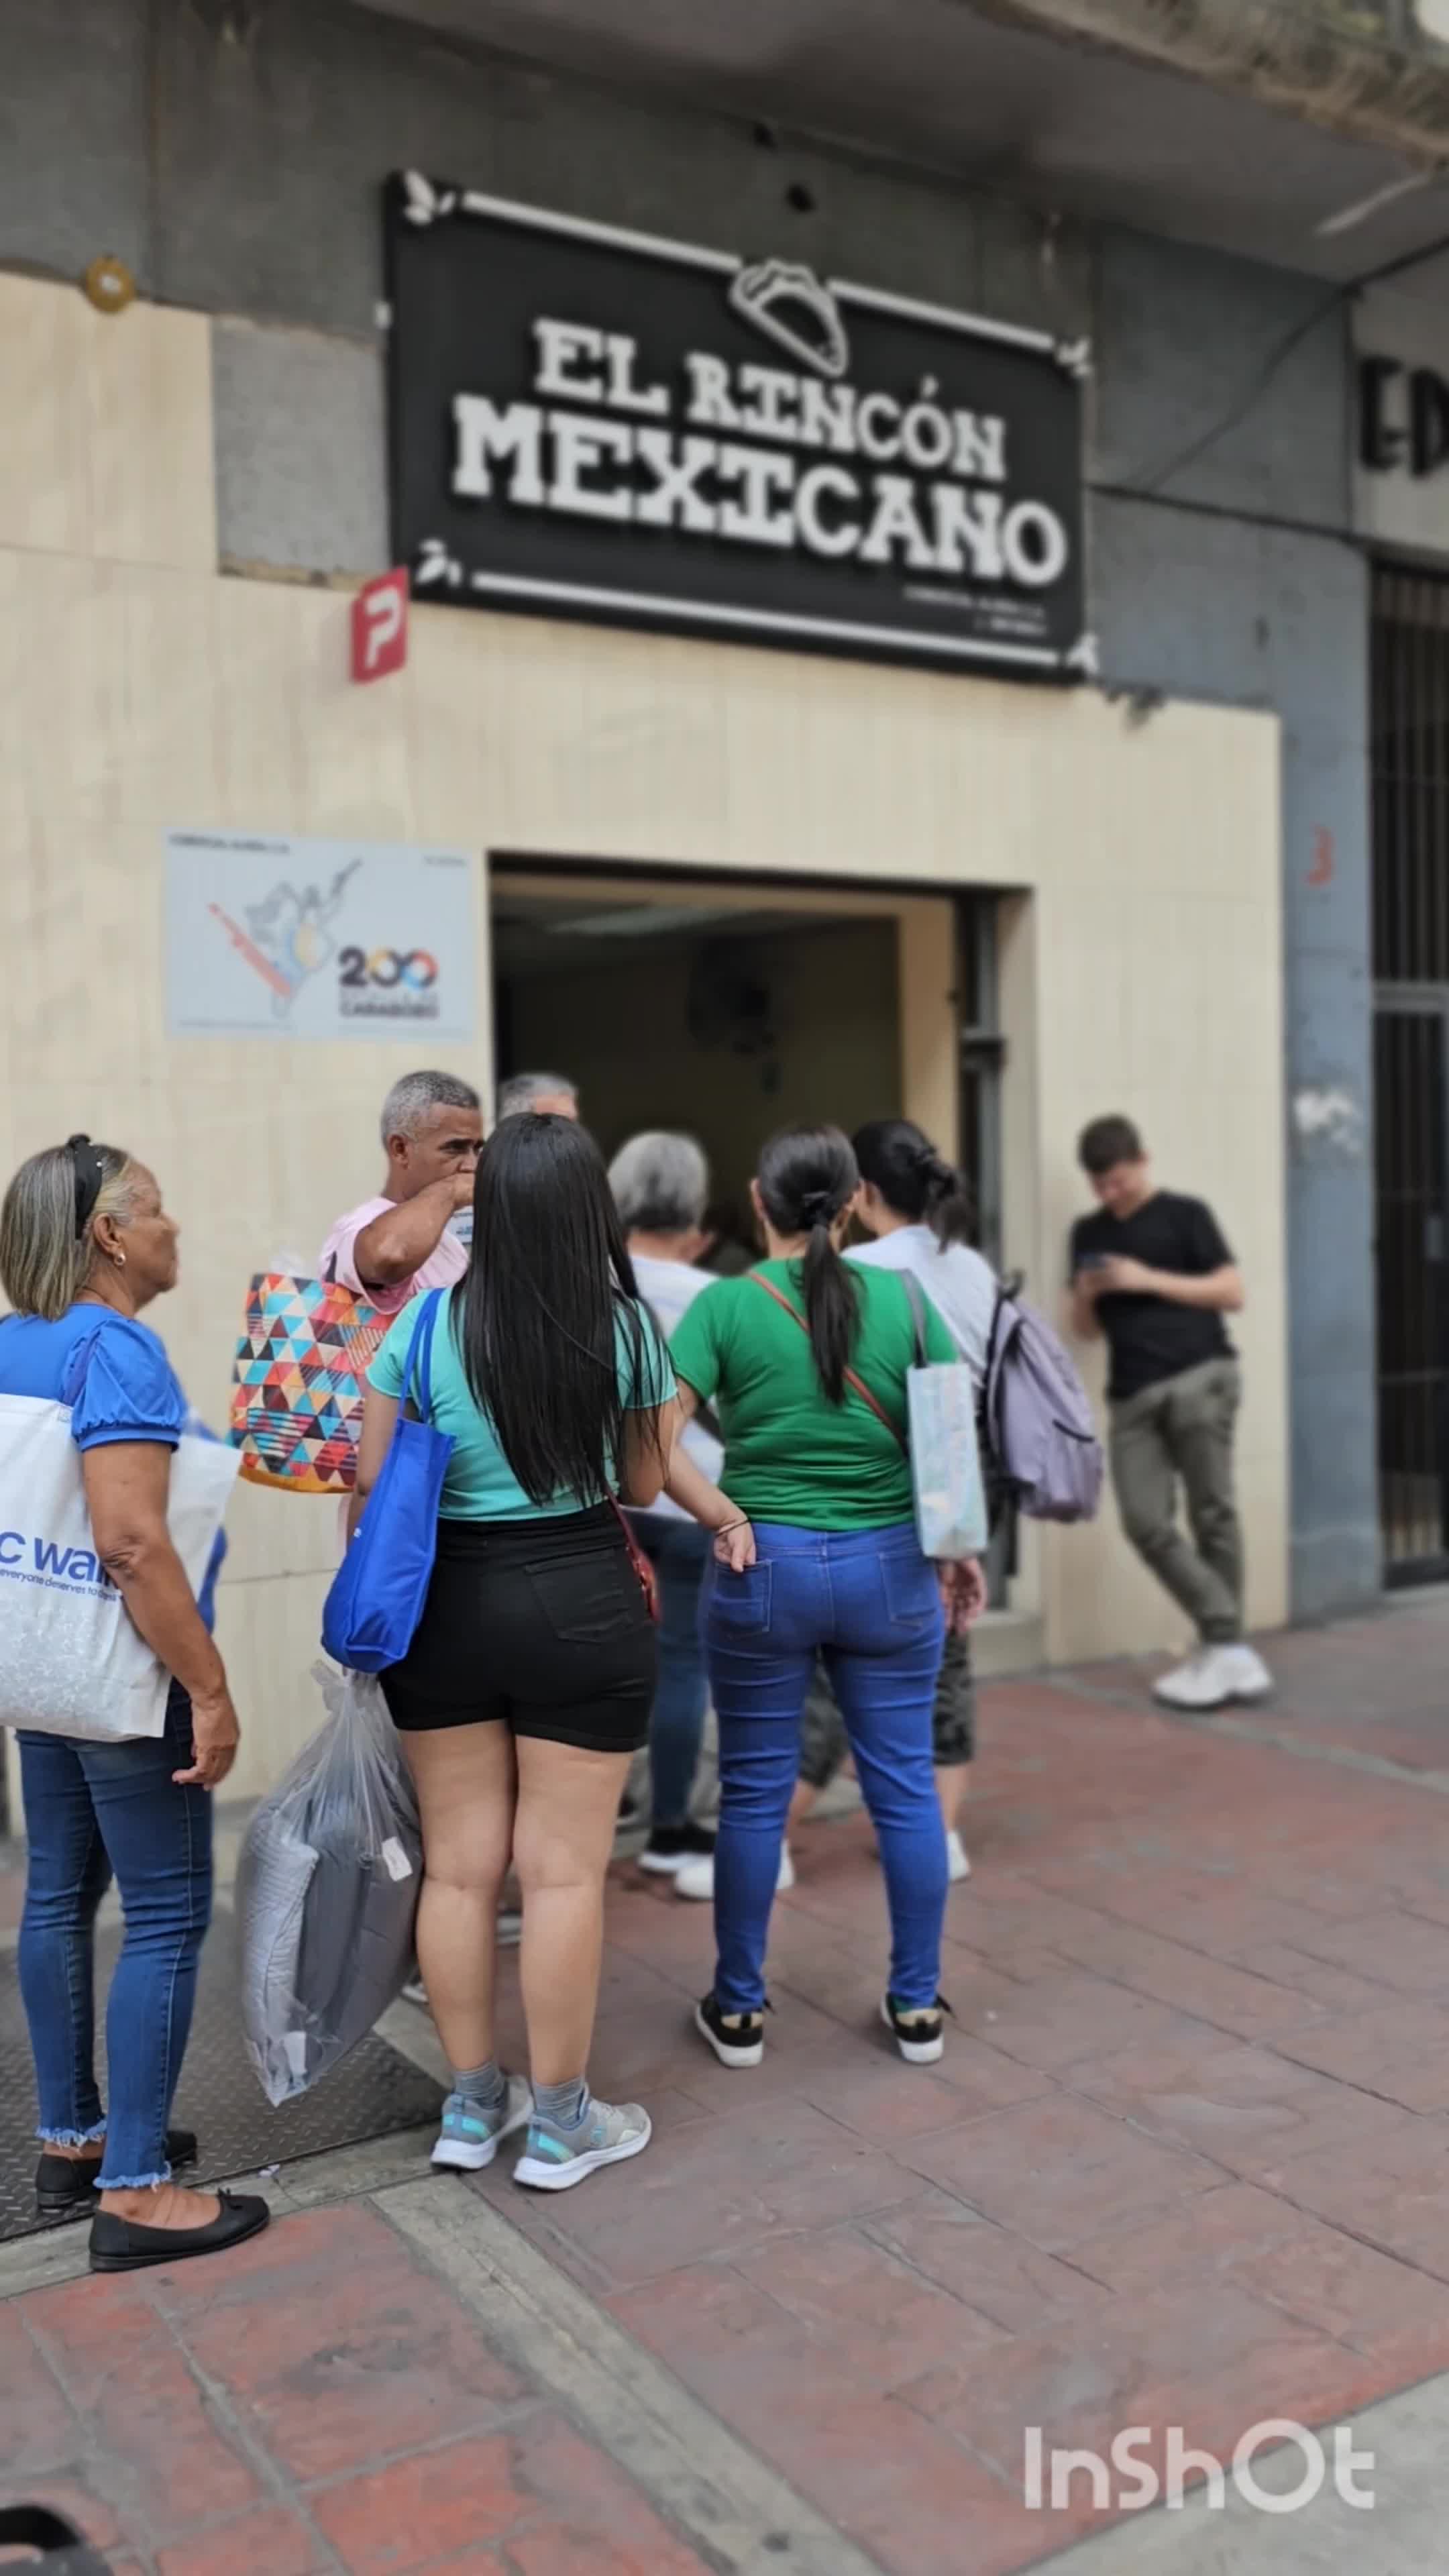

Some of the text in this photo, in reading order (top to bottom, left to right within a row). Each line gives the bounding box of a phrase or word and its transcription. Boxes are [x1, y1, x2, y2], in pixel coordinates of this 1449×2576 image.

[533, 318, 1007, 481] EL RINCÓN
[451, 393, 1068, 584] MEXICANO
[337, 946, 440, 989] 200
[0, 1568, 44, 1584] everyone
[45, 1577, 86, 1594] deserves
